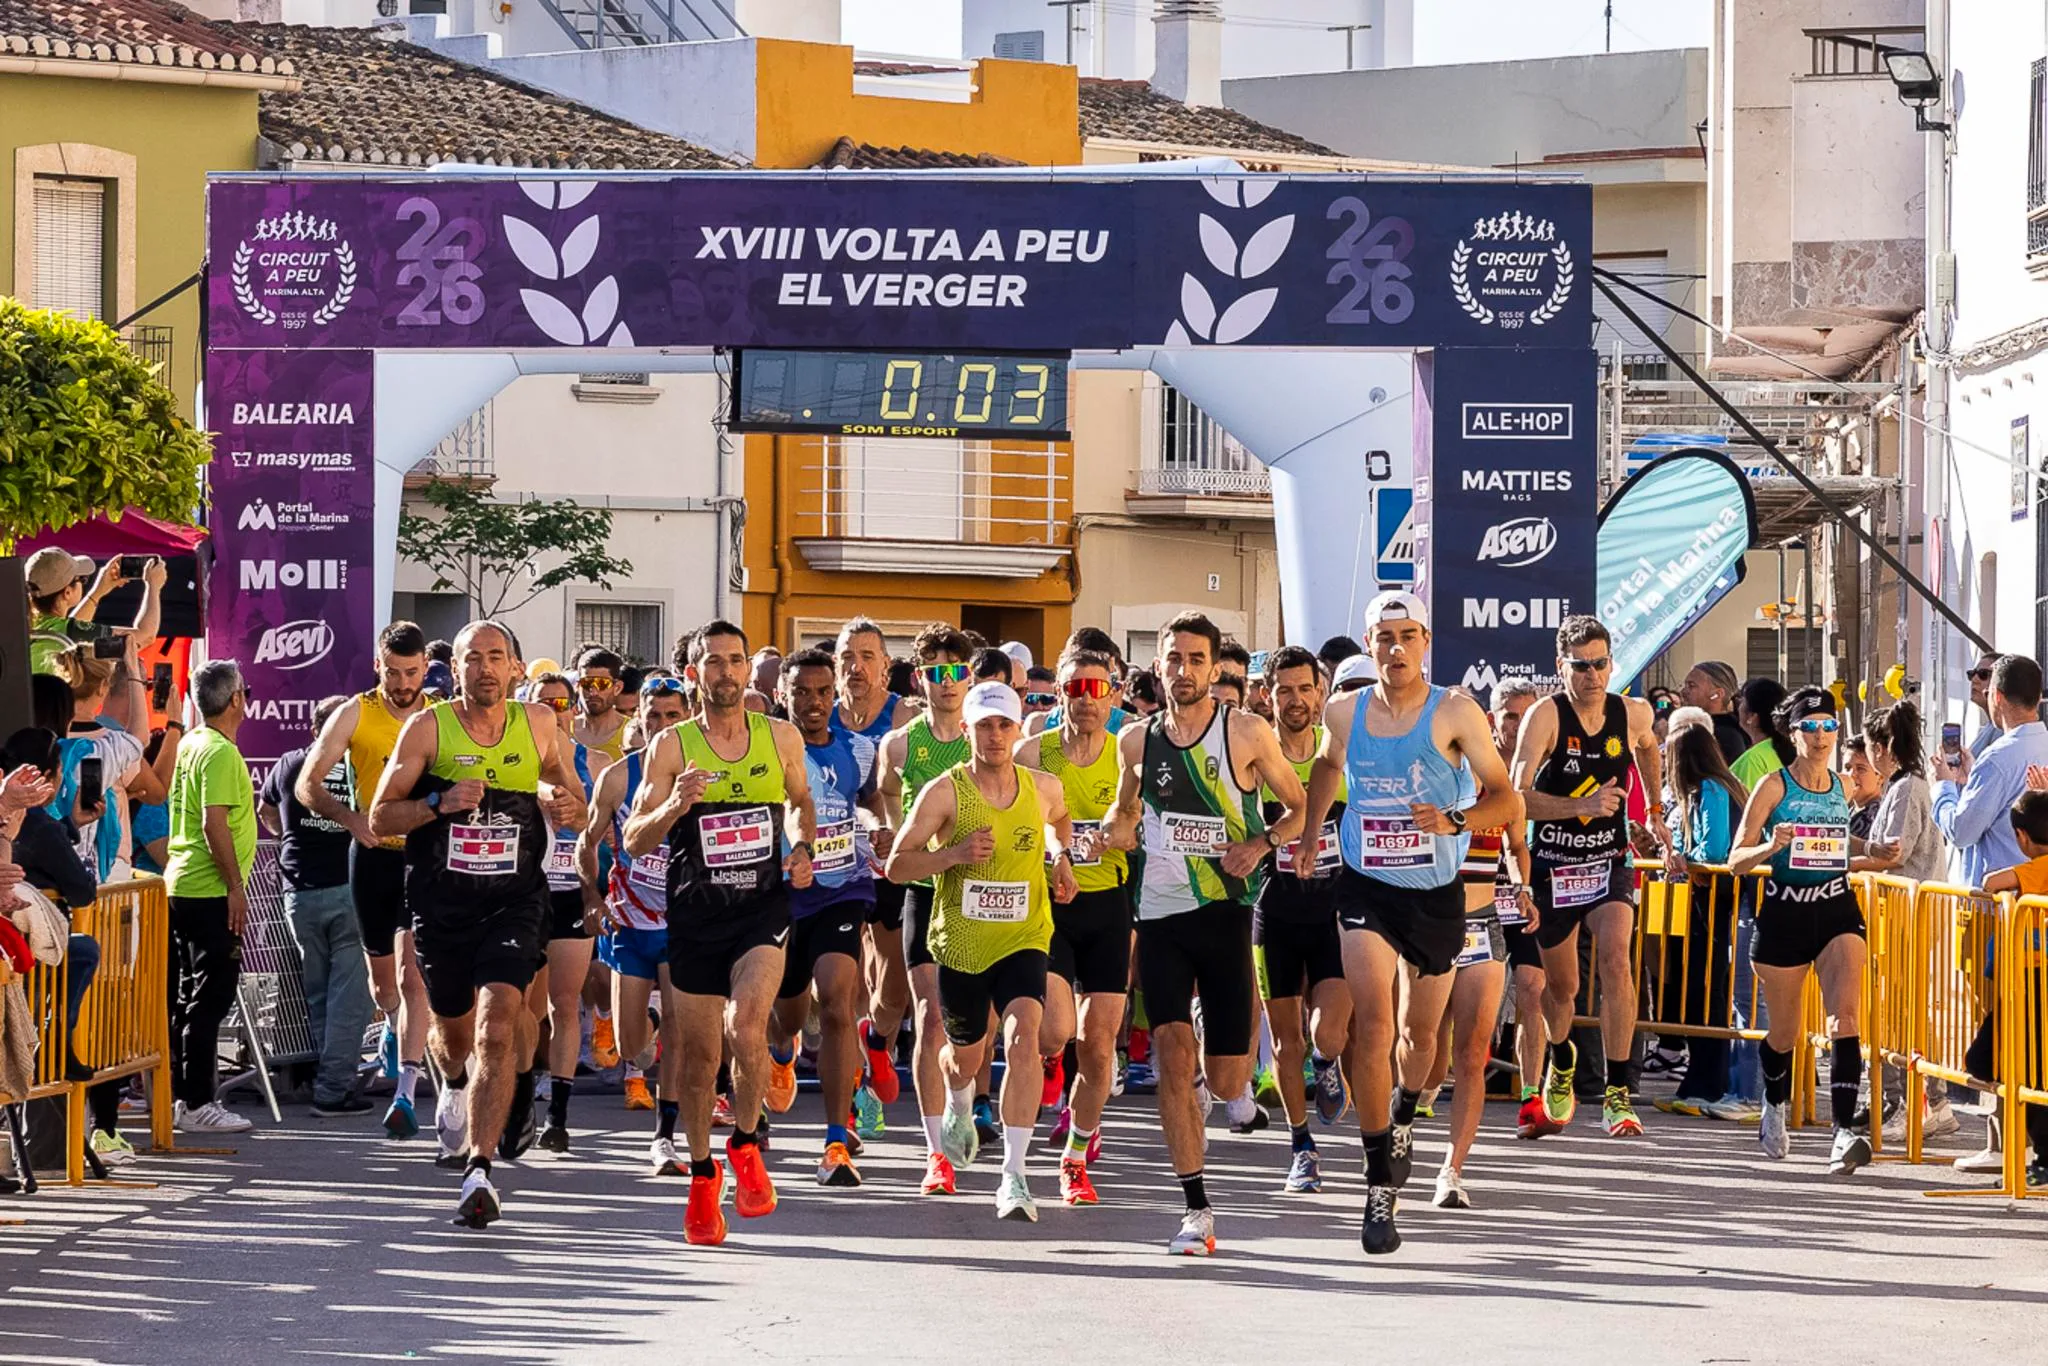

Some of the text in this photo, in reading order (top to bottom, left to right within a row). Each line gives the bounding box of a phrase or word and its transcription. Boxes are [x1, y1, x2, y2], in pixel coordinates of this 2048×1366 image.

[695, 226, 1109, 263] XVIII VOLTA A PEU
[258, 252, 331, 266] CIRCUIT
[1476, 252, 1549, 266] CIRCUIT
[266, 268, 322, 283] A PEU
[1484, 268, 1539, 282] A PEU
[263, 288, 325, 296] MARINA ALTA
[778, 273, 1028, 307] EL VERGER
[1481, 288, 1543, 296] MARINA ALTA
[282, 319, 307, 329] 1997
[1500, 319, 1524, 329] 1997
[1472, 412, 1564, 431] ALE-HOP
[842, 423, 959, 438] SOM ESPORT
[256, 452, 353, 469] masymas
[1461, 470, 1573, 491] MATTIES
[1502, 493, 1532, 501] BAGS
[277, 502, 313, 513] Portal
[277, 512, 350, 523] de la Marina
[1476, 516, 1550, 561] Asevi
[239, 559, 338, 590] Moll
[1609, 505, 1739, 650] de la Marina
[1601, 556, 1658, 621] ortal
[1462, 598, 1560, 629] Moll
[253, 619, 327, 665] Asevi
[1500, 663, 1535, 674] Portal
[1531, 674, 1564, 685] Marin
[242, 700, 315, 721] MATTI
[279, 722, 309, 731] BAGS
[734, 831, 744, 843] 1
[1174, 826, 1209, 842] 3606
[479, 843, 490, 855] 2
[1378, 835, 1417, 849] 1697
[1810, 841, 1833, 853] 481
[552, 855, 569, 867] 86
[1780, 876, 1846, 903] NIKE
[979, 894, 1014, 908] 3605
